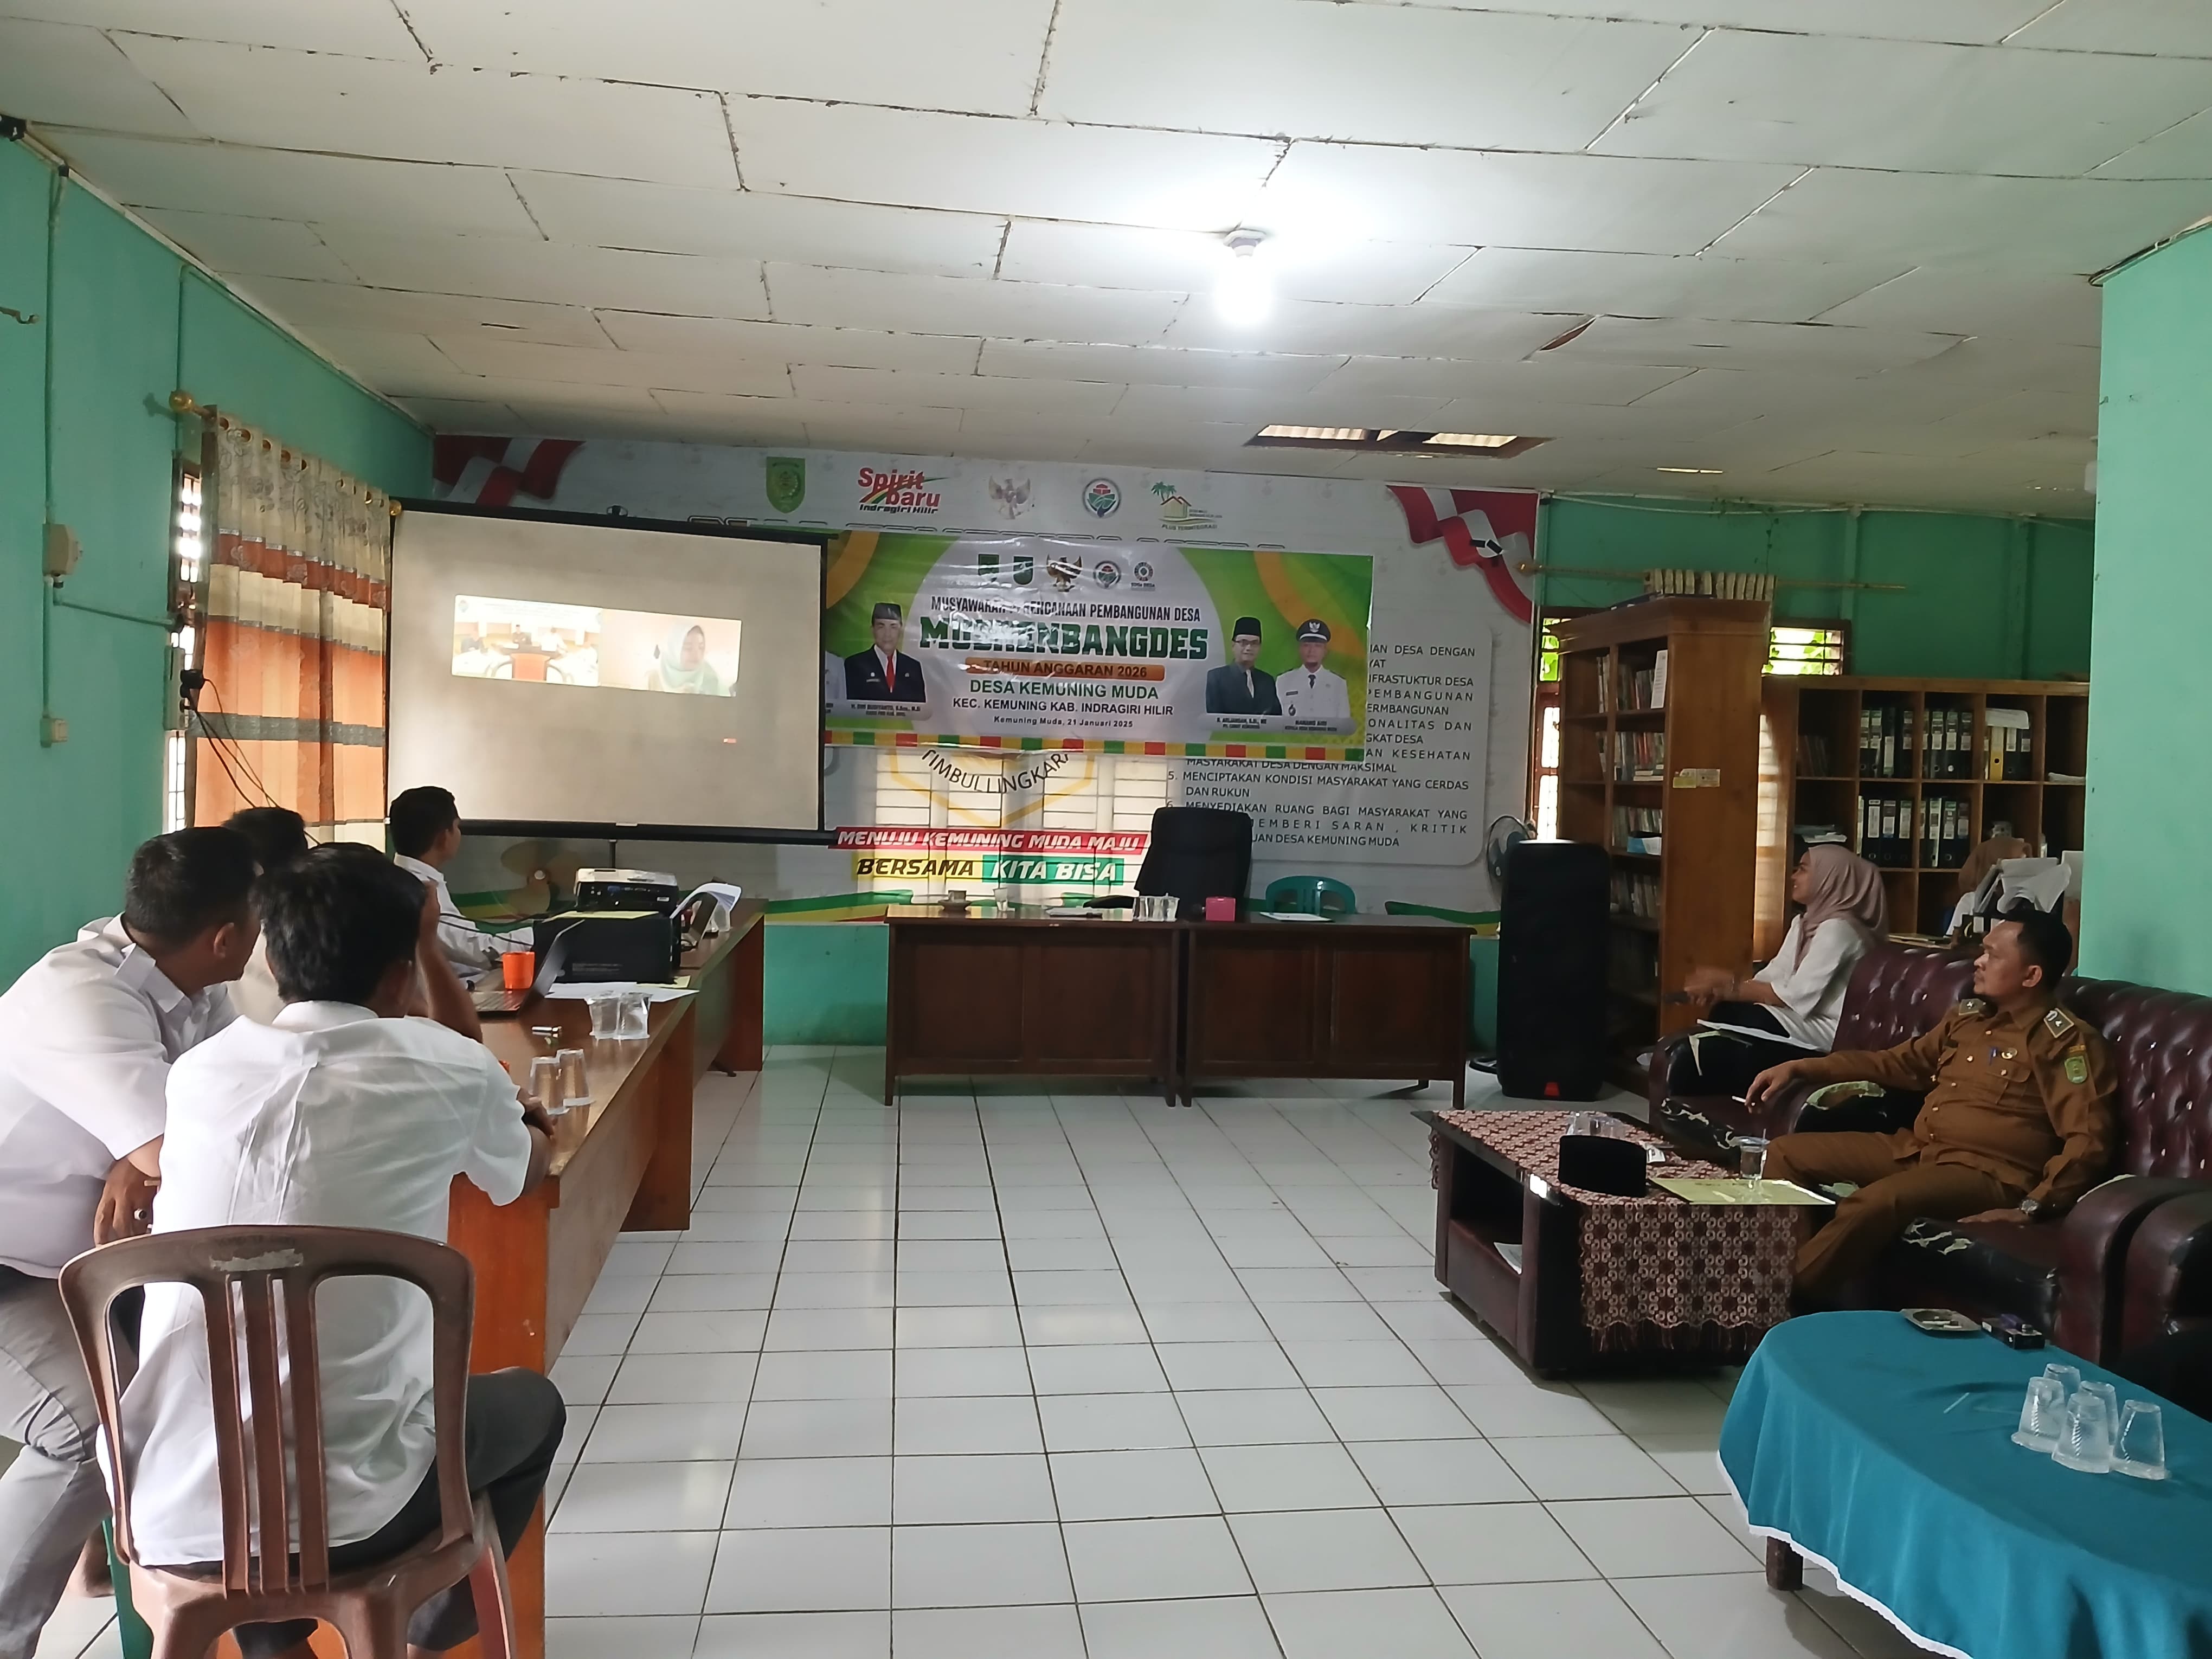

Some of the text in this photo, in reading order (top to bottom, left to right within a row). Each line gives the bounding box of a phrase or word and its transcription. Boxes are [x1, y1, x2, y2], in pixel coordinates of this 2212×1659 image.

[858, 467, 925, 493] Spirit
[885, 486, 941, 507] baru
[859, 504, 910, 514] Indragiri
[1090, 603, 1170, 620] PEMBANGUNAN
[1174, 607, 1200, 622] DESA
[920, 616, 1208, 660] MUENBANGDES
[1394, 645, 1423, 655] DESA
[1430, 646, 1475, 657] DENGAN
[983, 660, 1147, 677] TAHUN ANGGARAN 2026
[970, 680, 1159, 699] DESA KEMUNING MUDA
[1445, 677, 1474, 686] DESA
[953, 698, 1173, 715] KEC. KEMUNING KAB. INDRAGIRI HILIR
[994, 716, 1037, 725] Kemuning
[1040, 718, 1065, 726] Muda,
[1445, 722, 1471, 731] DAN
[1395, 735, 1423, 744] DESA
[1393, 749, 1470, 760] KESEHATAN
[1187, 759, 1397, 773] MASYARAKAT DESA DENGAN MAKSIMAL
[1168, 771, 1469, 790] 5. MENCIPTAKAN KONDISI MASYARAKAT YANG CERDAS
[1186, 787, 1250, 798] DAN RUKUN
[1186, 801, 1266, 813] MENYEDIAKAN
[1275, 804, 1314, 814] RUANG
[1323, 806, 1349, 815] BAGI
[1359, 807, 1430, 818] MASYARAKAT
[1438, 810, 1467, 819] YANG
[1251, 819, 1319, 829] EMBERI
[1332, 821, 1384, 831] SARAN
[1411, 824, 1467, 834] KRITIK
[838, 831, 1140, 851] MENUJU KEMUNING MUDA MAJU
[1276, 834, 1304, 844] DESA
[1307, 835, 1366, 846] KEMUNING
[1368, 837, 1399, 846] MUDA
[857, 858, 1116, 881] BERSAMA KITA BISA
